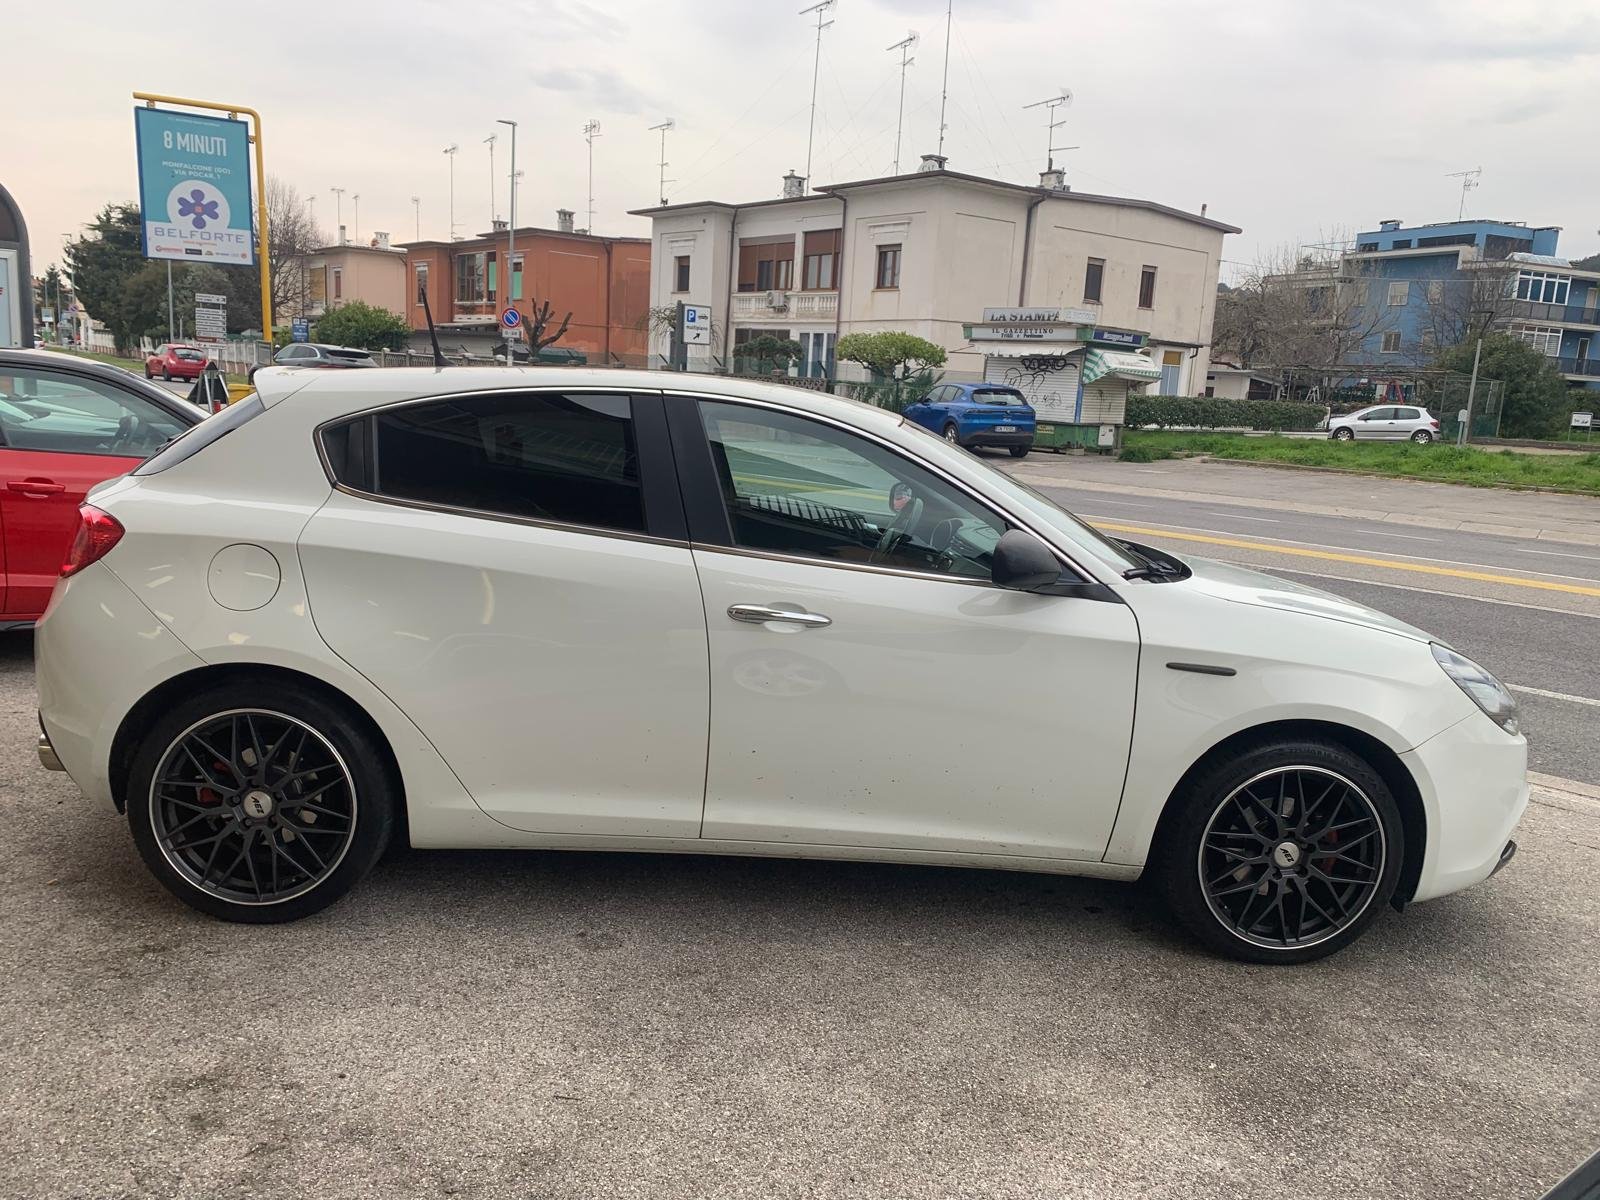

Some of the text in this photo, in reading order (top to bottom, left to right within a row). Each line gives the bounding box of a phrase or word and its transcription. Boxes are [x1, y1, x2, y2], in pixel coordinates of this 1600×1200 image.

[163, 130, 227, 157] 8 MINUTI
[162, 160, 212, 172] MONFALCONE
[174, 168, 187, 176] VIA
[154, 226, 245, 244] BELFORTE
[990, 312, 1006, 322] LA
[1003, 327, 1054, 335] GAZZETTINO
[1279, 847, 1295, 863] AEZ
